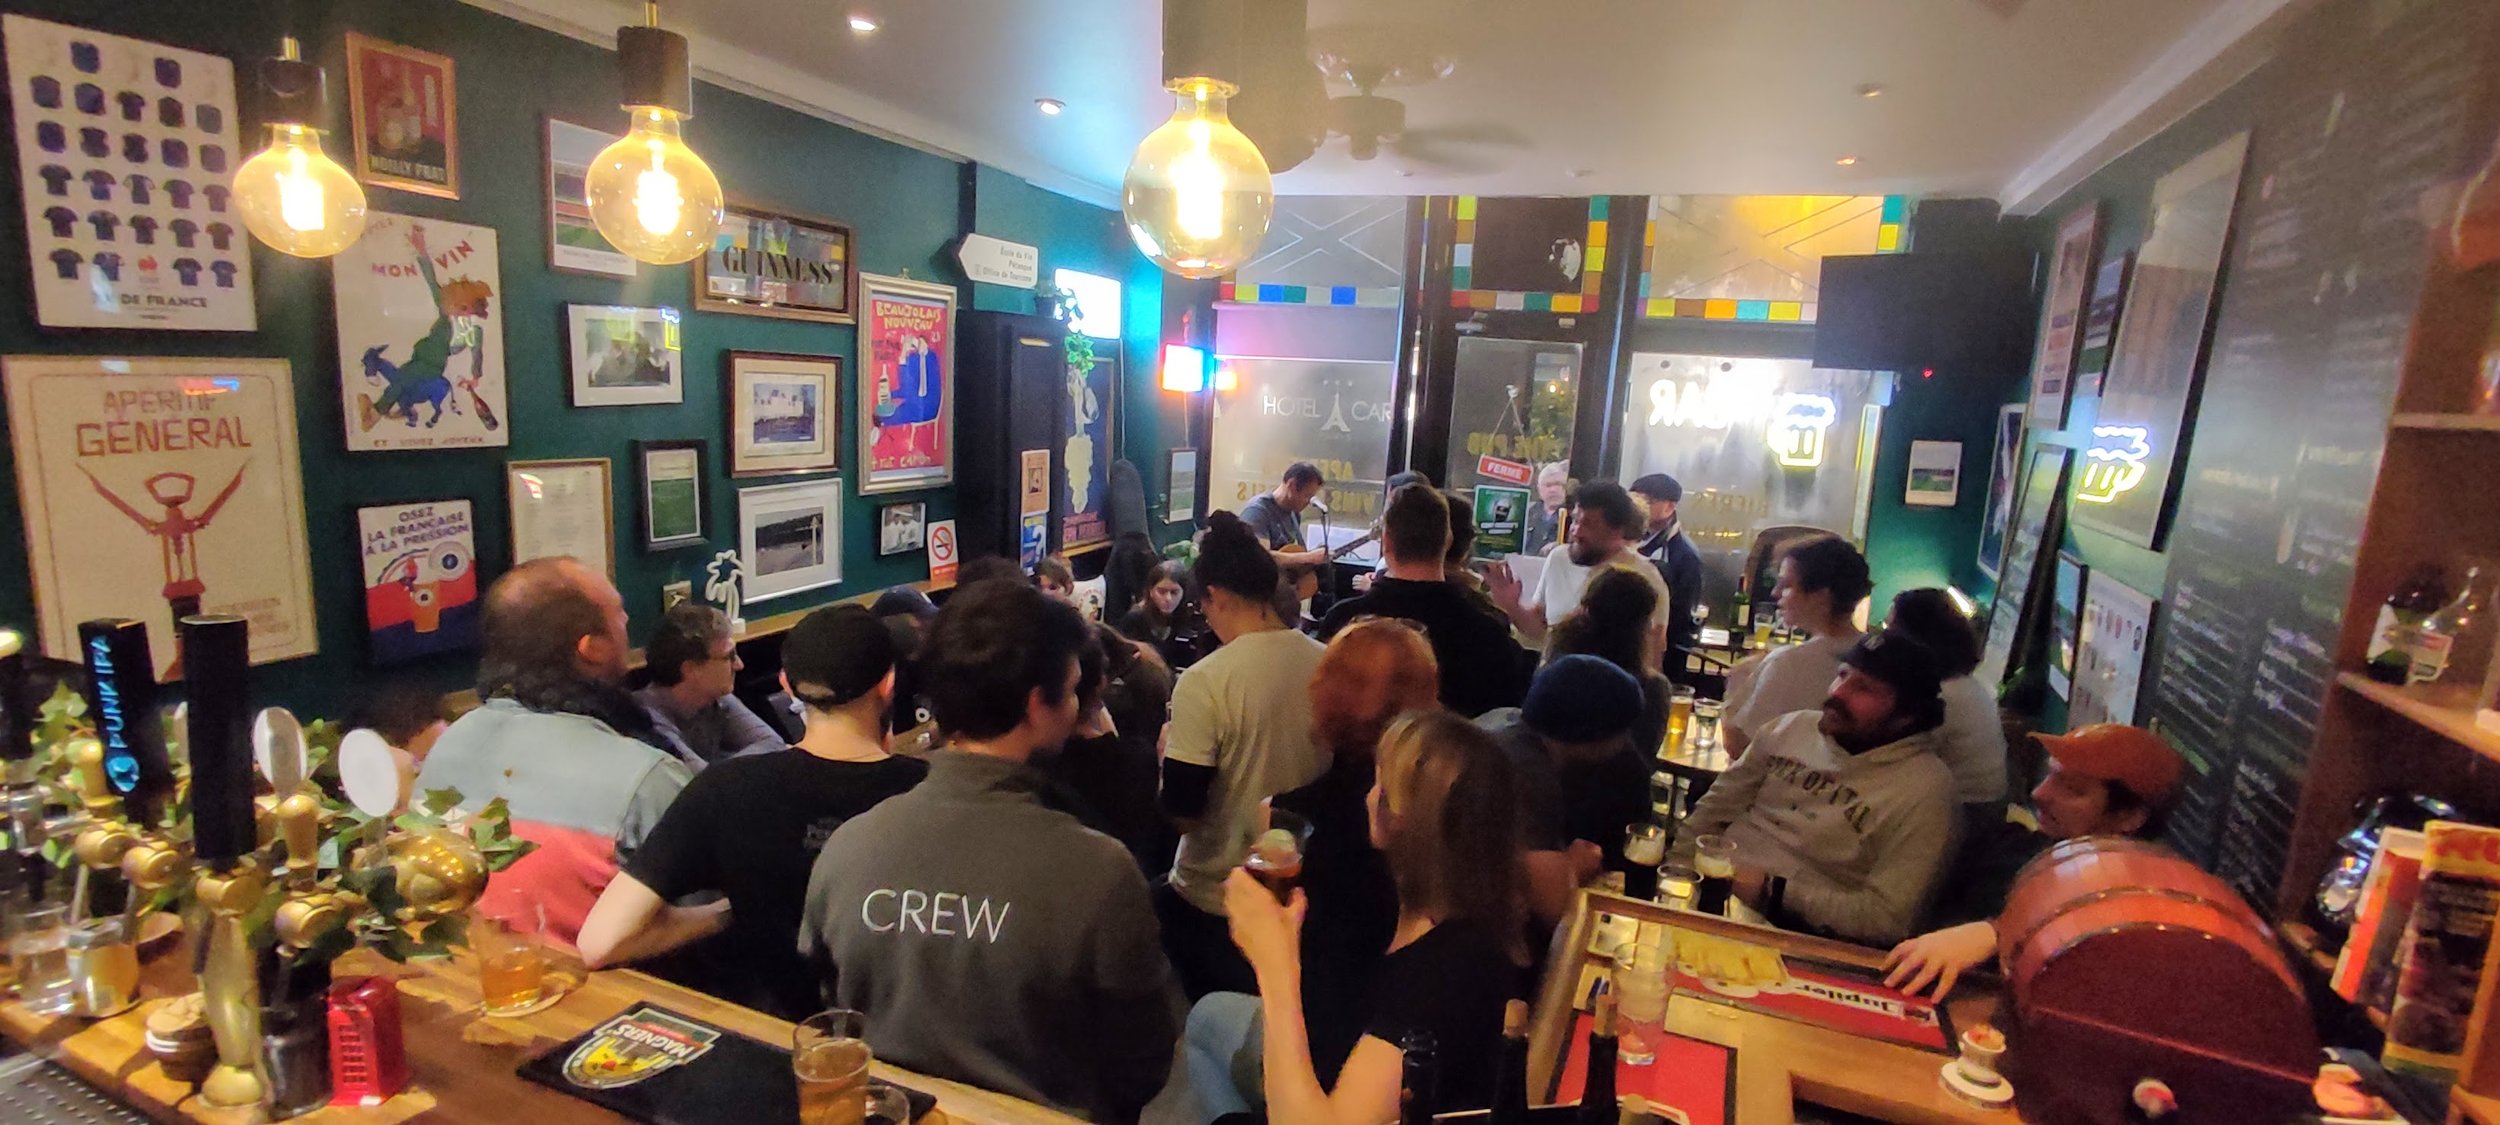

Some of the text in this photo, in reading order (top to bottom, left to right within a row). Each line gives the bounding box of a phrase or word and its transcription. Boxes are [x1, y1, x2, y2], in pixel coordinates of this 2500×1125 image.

[372, 240, 474, 277] MON VIN
[722, 245, 833, 284] GUINNESS
[120, 293, 207, 308] DE FRANCE
[876, 301, 941, 322] BEAUJOLAIS
[883, 317, 933, 331] NOUVEAU
[399, 506, 433, 522] OSEZ
[368, 530, 385, 542] LA
[381, 540, 398, 552] LA
[403, 523, 469, 547] PRESSION
[90, 634, 128, 748] PUNK IPA
[861, 888, 1010, 943] CREW
[1794, 983, 1898, 1014] Jupiler
[613, 1024, 695, 1058] MAGNERS
